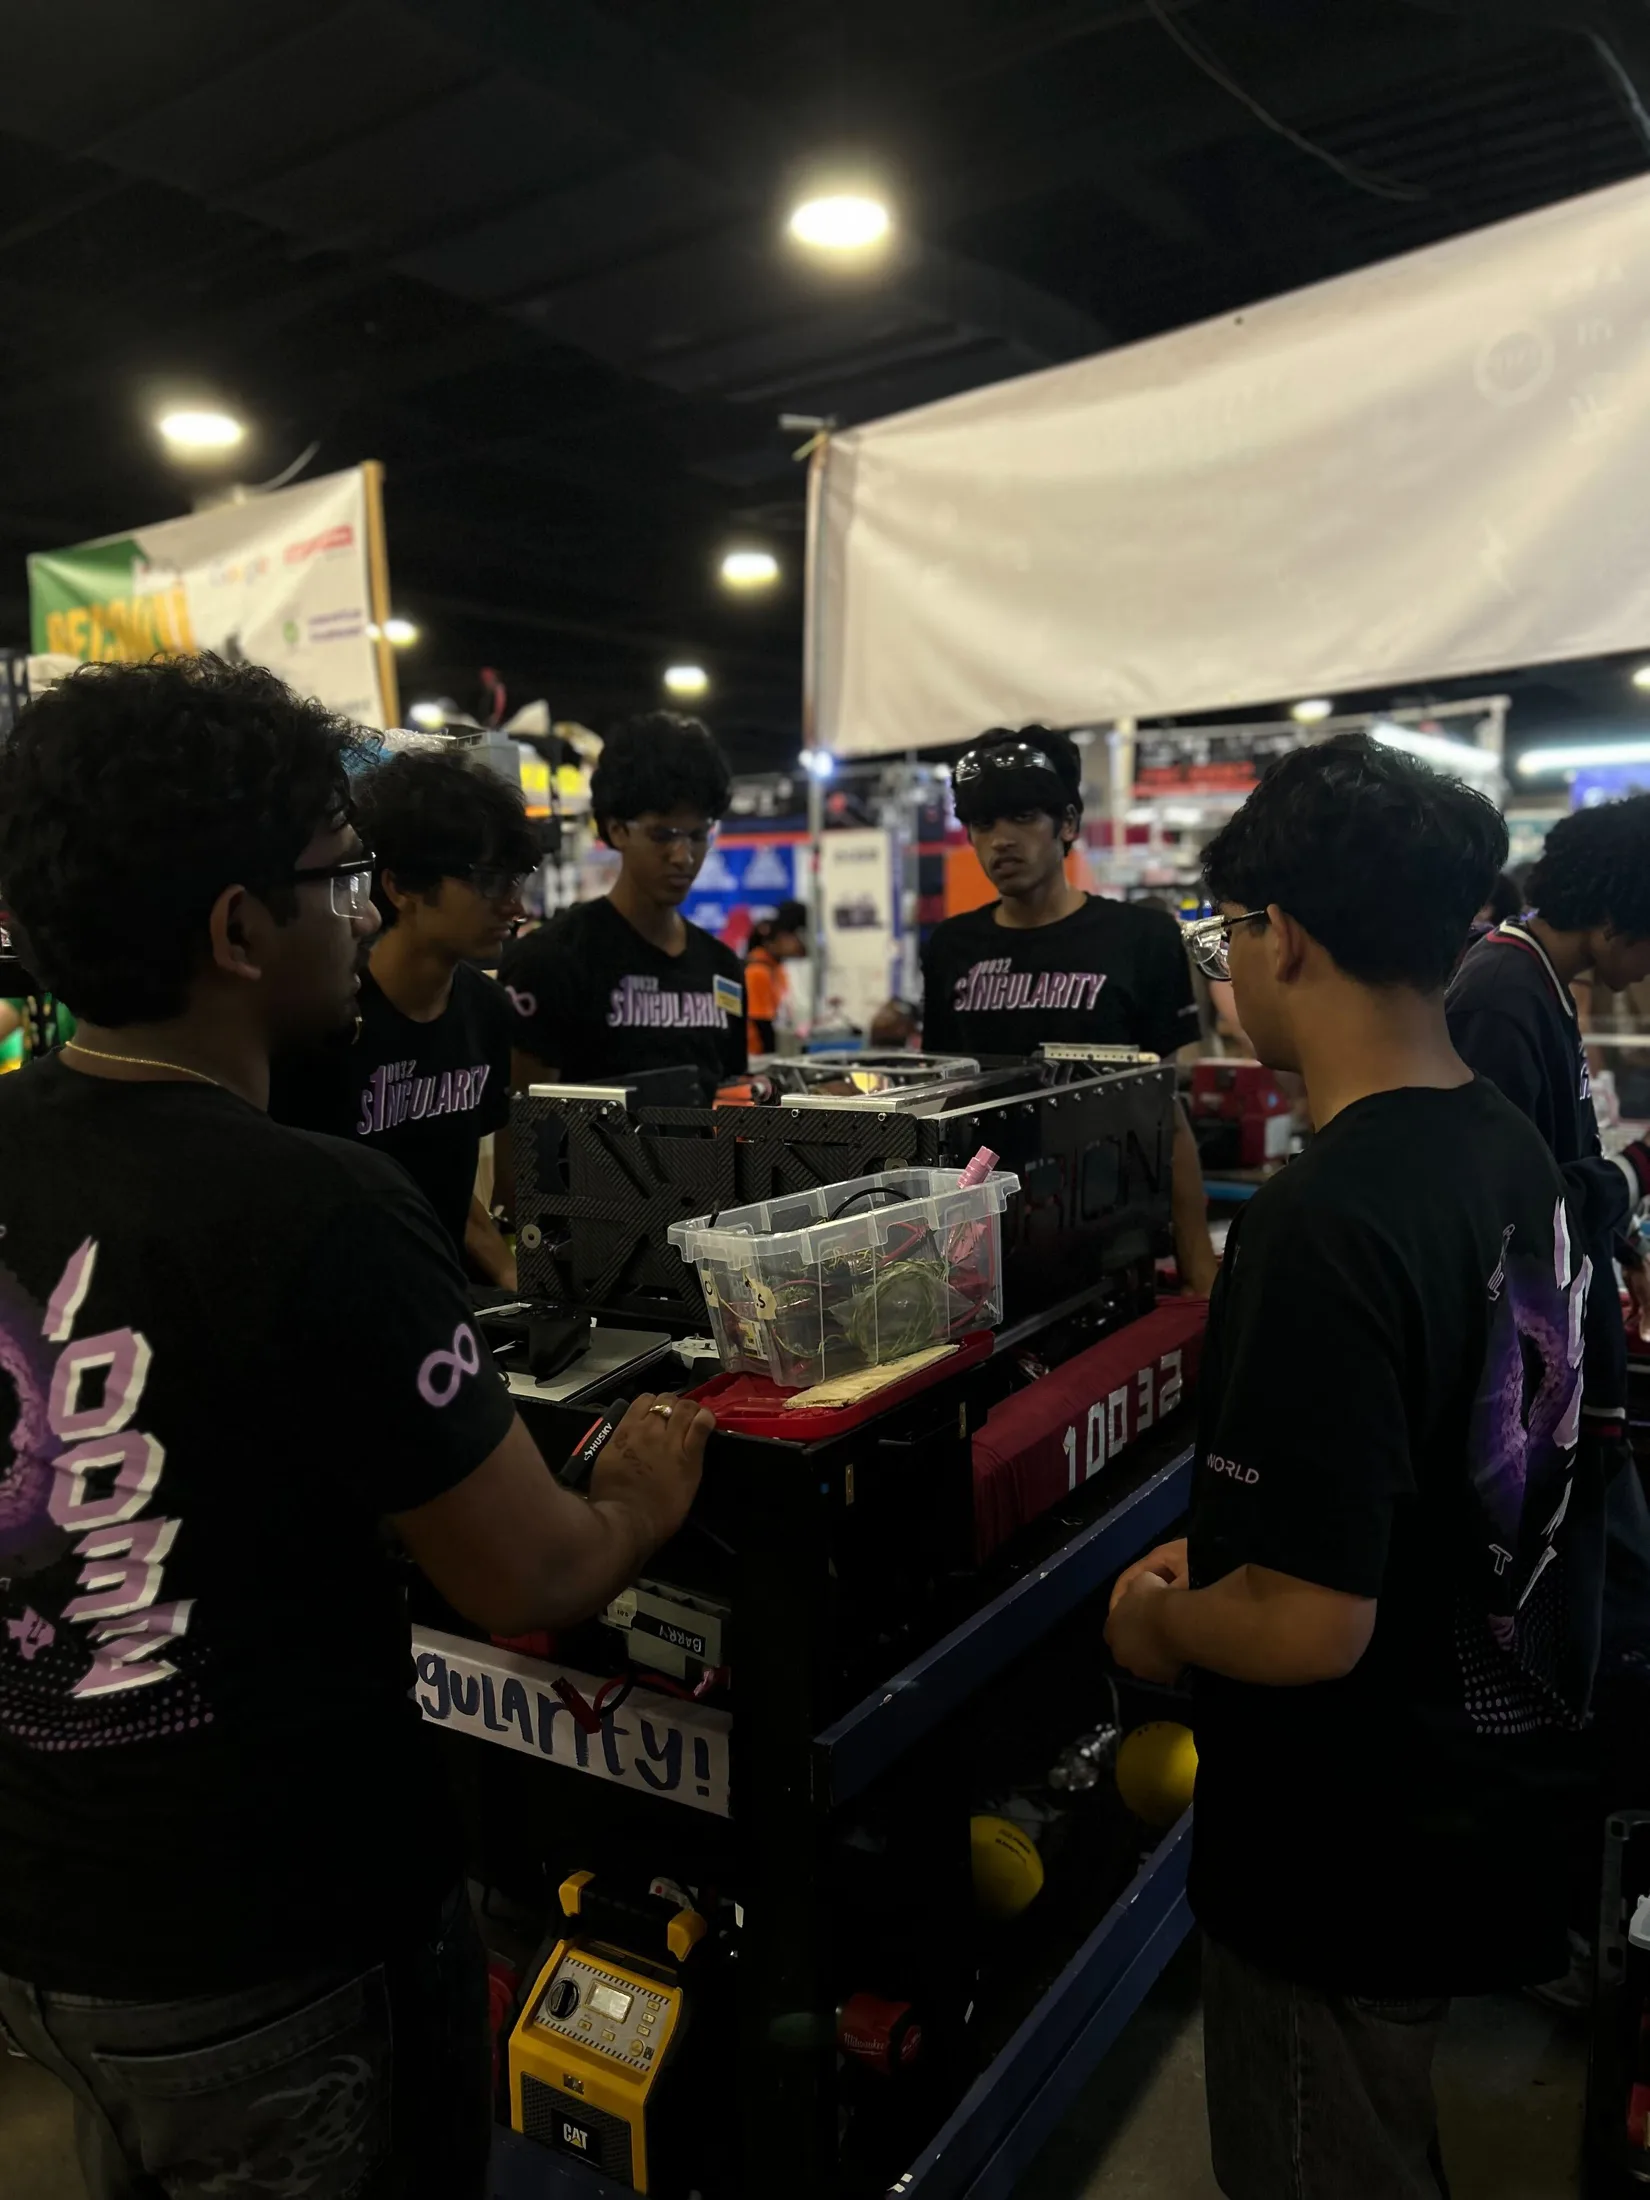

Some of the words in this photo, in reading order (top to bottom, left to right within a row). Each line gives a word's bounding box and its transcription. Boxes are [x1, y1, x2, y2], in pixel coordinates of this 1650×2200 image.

[953, 968, 1108, 1012] SINGULARITY
[356, 1063, 491, 1136] SINGULARTY
[590, 1422, 613, 1452] HUSKY
[1062, 1348, 1183, 1492] 10032
[42, 1235, 197, 1699] 10032
[1206, 1452, 1260, 1485] WORLD
[659, 1624, 703, 1653] BARRY
[563, 2122, 588, 2151] CAT
